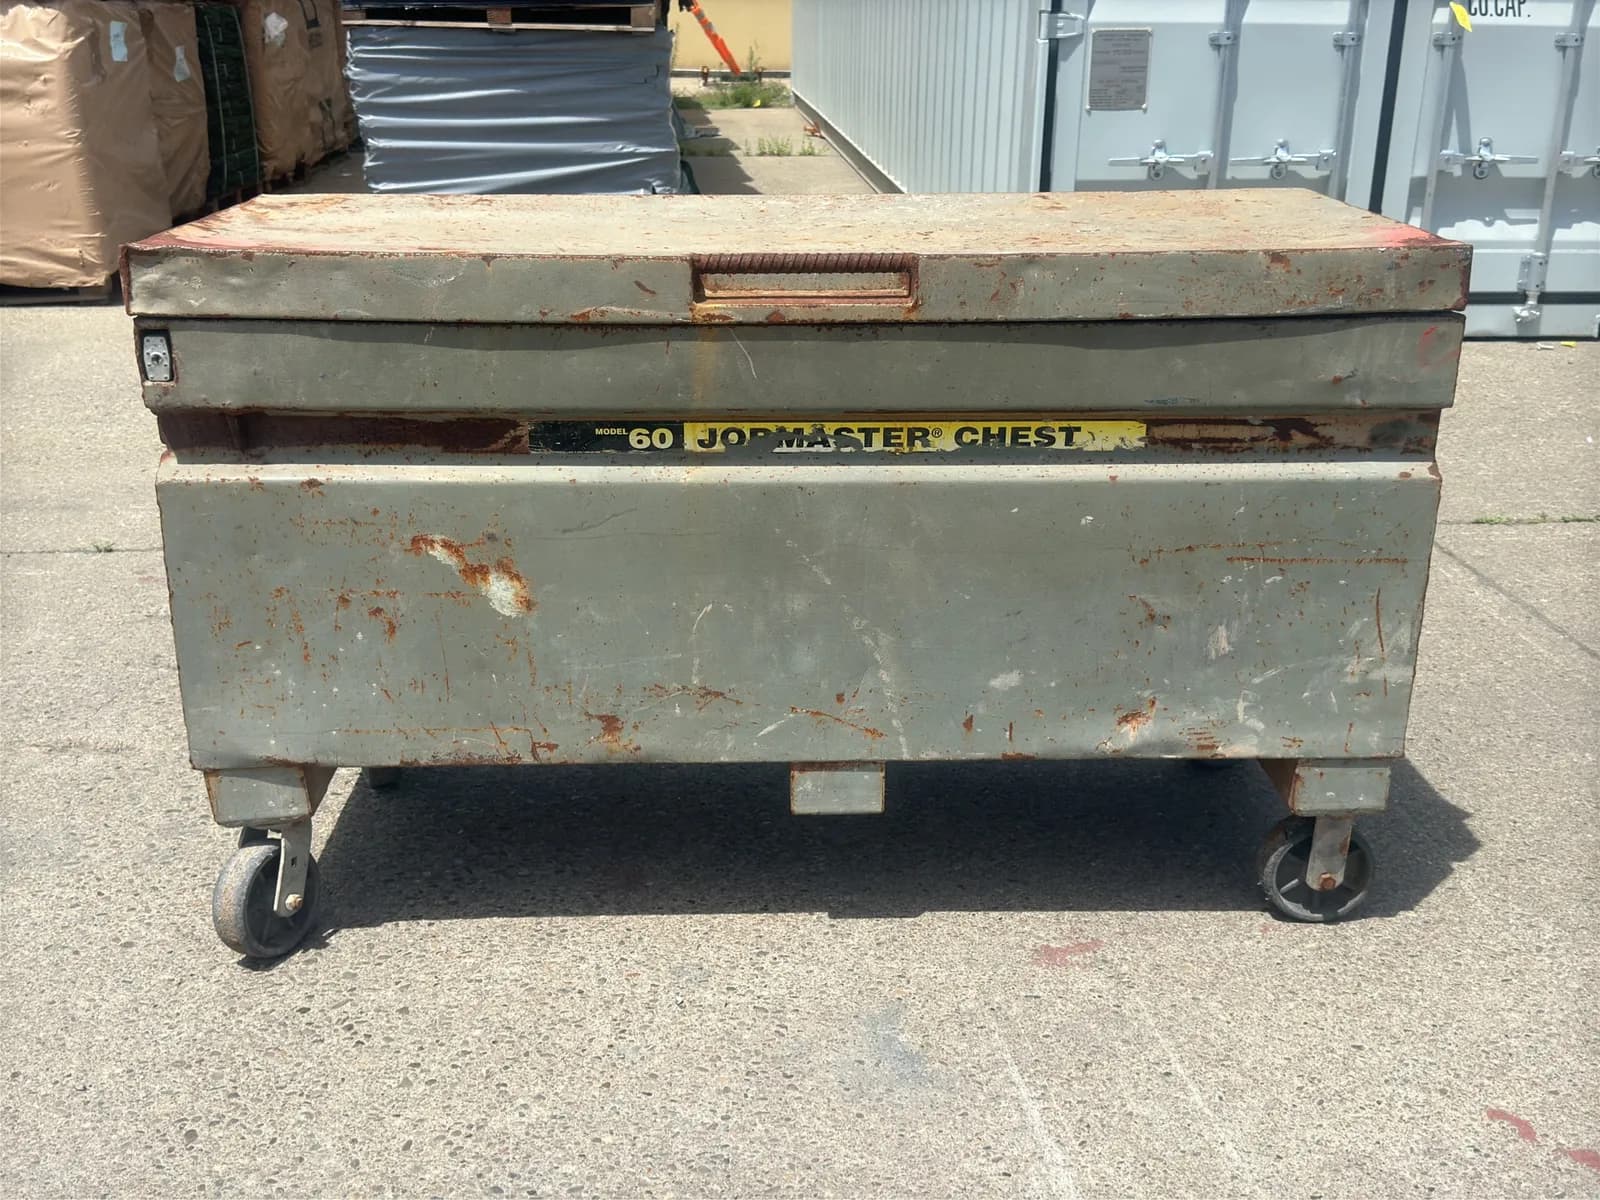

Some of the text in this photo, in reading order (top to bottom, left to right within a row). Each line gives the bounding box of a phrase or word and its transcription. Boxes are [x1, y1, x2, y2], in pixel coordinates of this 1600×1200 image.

[595, 428, 628, 436] MODEL
[628, 428, 674, 449] 60
[954, 426, 1082, 448] CHEST
